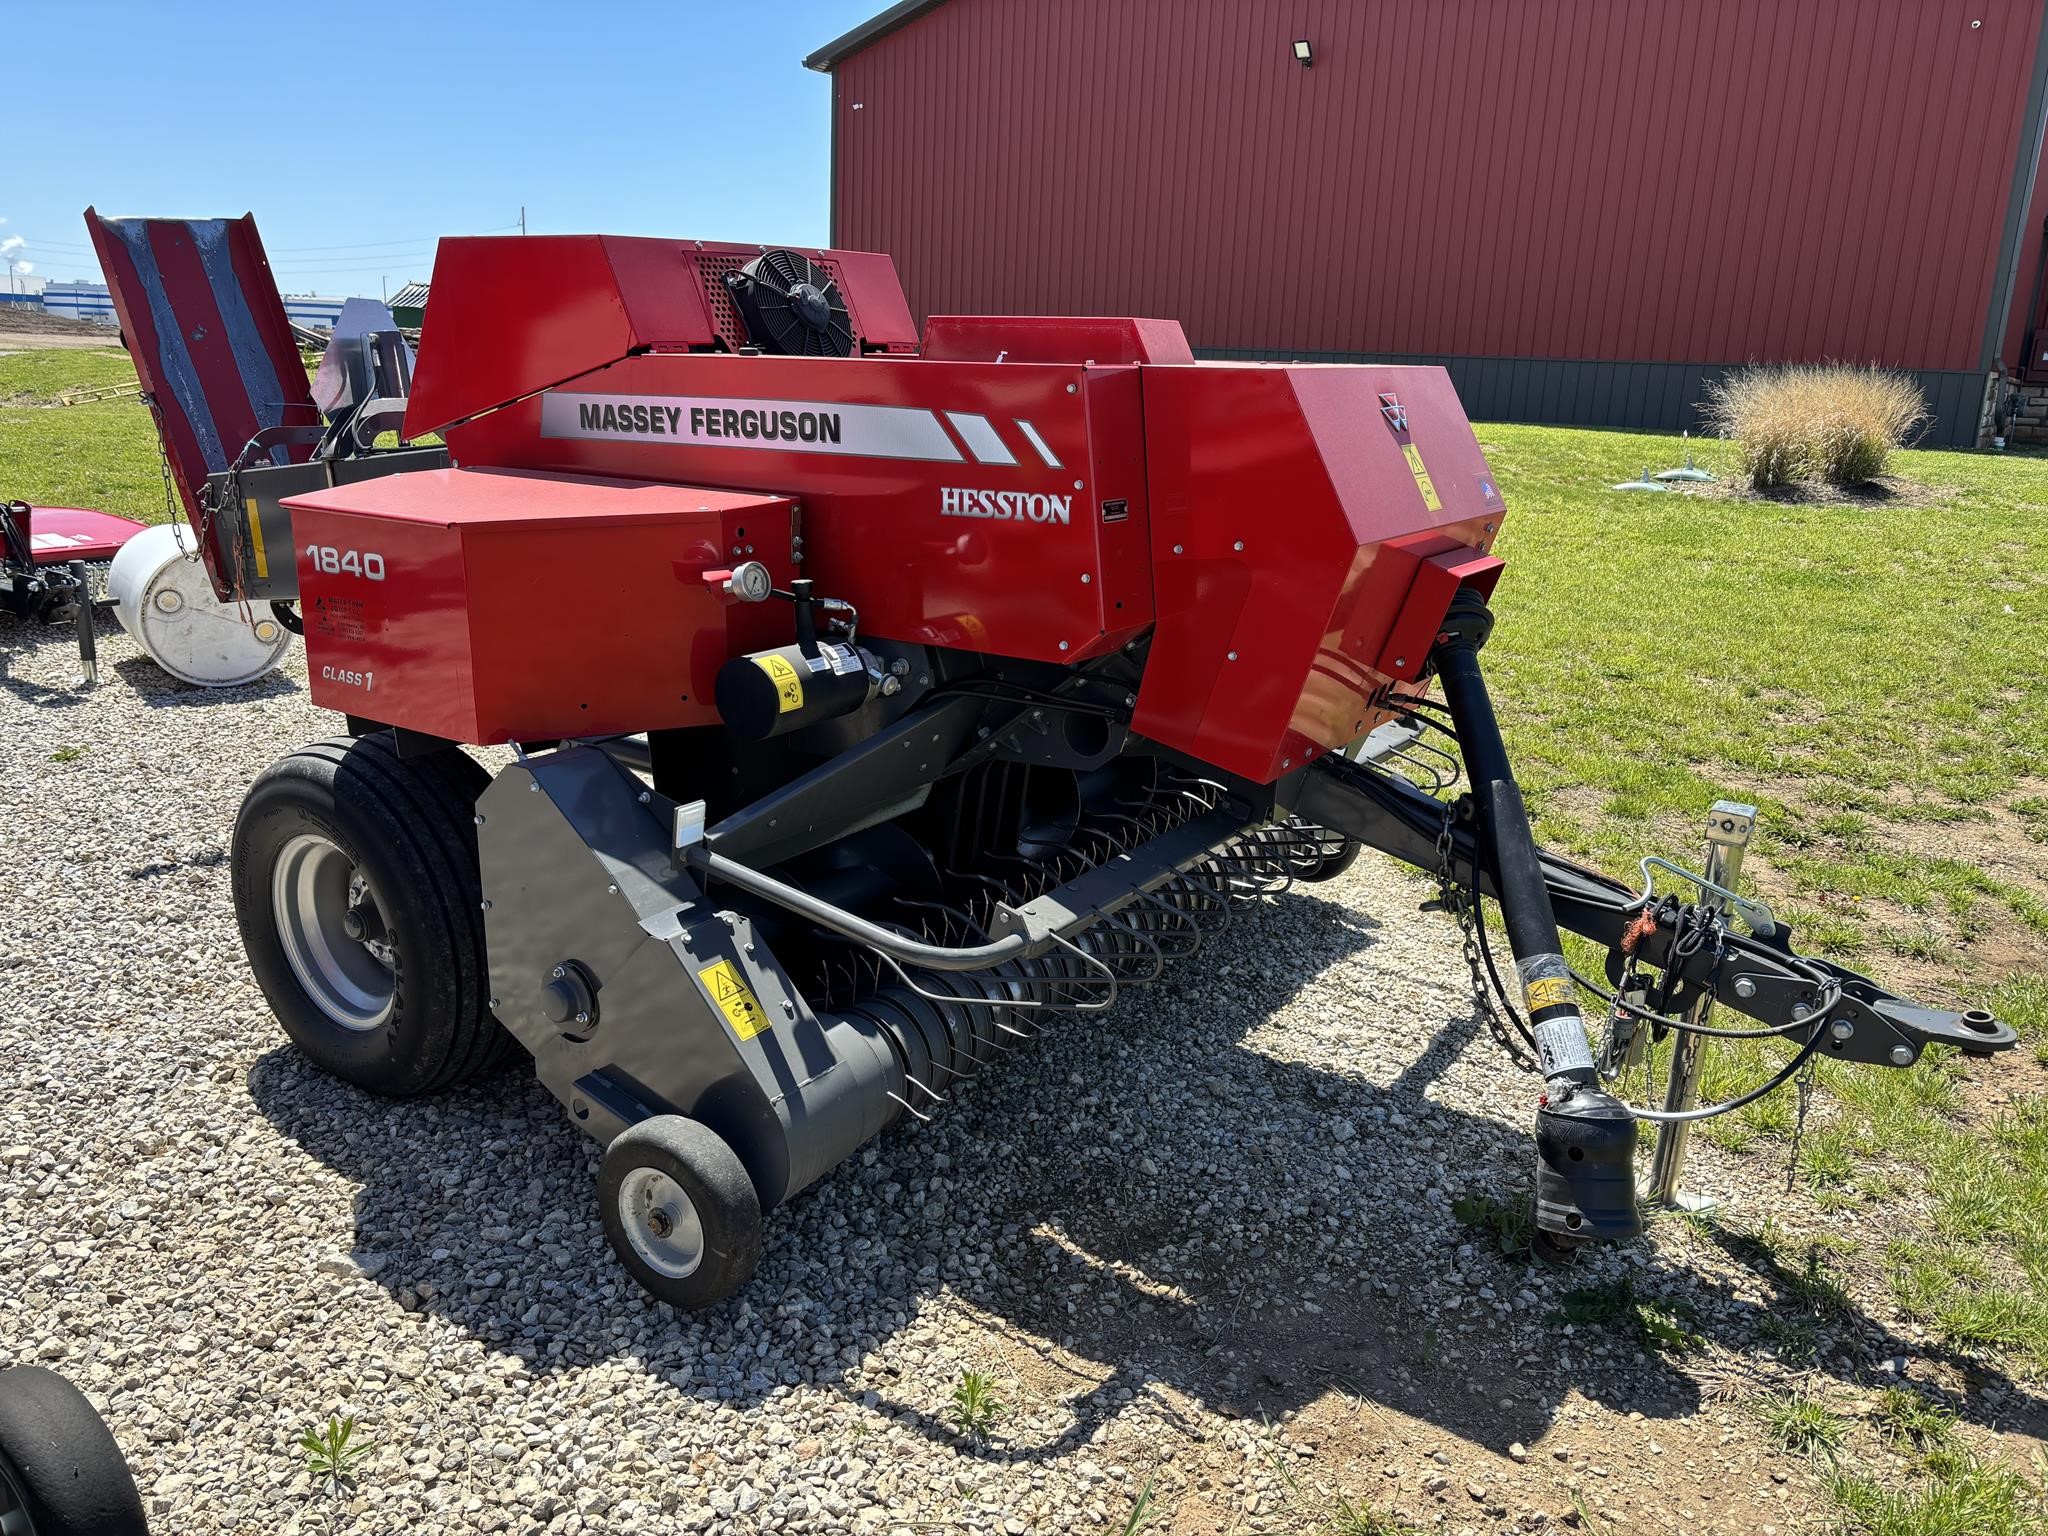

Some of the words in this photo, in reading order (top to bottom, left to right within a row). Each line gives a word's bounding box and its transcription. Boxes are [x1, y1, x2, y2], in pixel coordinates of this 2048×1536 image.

[579, 403, 682, 434] MASSEY
[690, 407, 842, 443] FERGUSON
[940, 487, 1072, 525] HESSTON
[306, 544, 385, 581] 1840
[322, 665, 363, 686] CLASS
[365, 671, 374, 692] 1
[387, 927, 404, 1049] GALAXY
